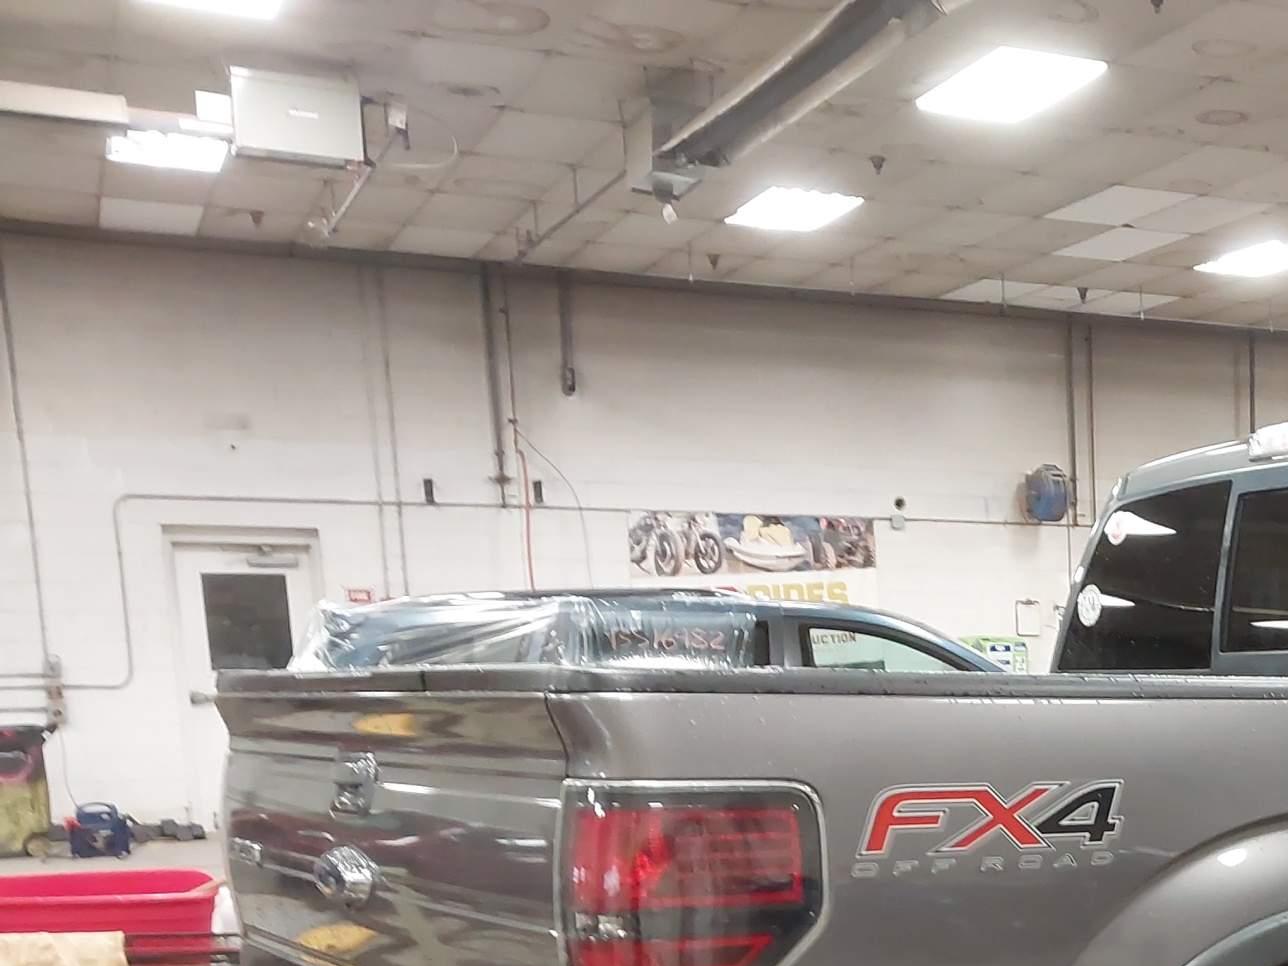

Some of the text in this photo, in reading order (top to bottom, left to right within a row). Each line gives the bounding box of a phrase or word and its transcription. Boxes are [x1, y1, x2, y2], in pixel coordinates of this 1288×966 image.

[856, 779, 1126, 857] FX4
[851, 851, 1115, 879] OFF ROAD
